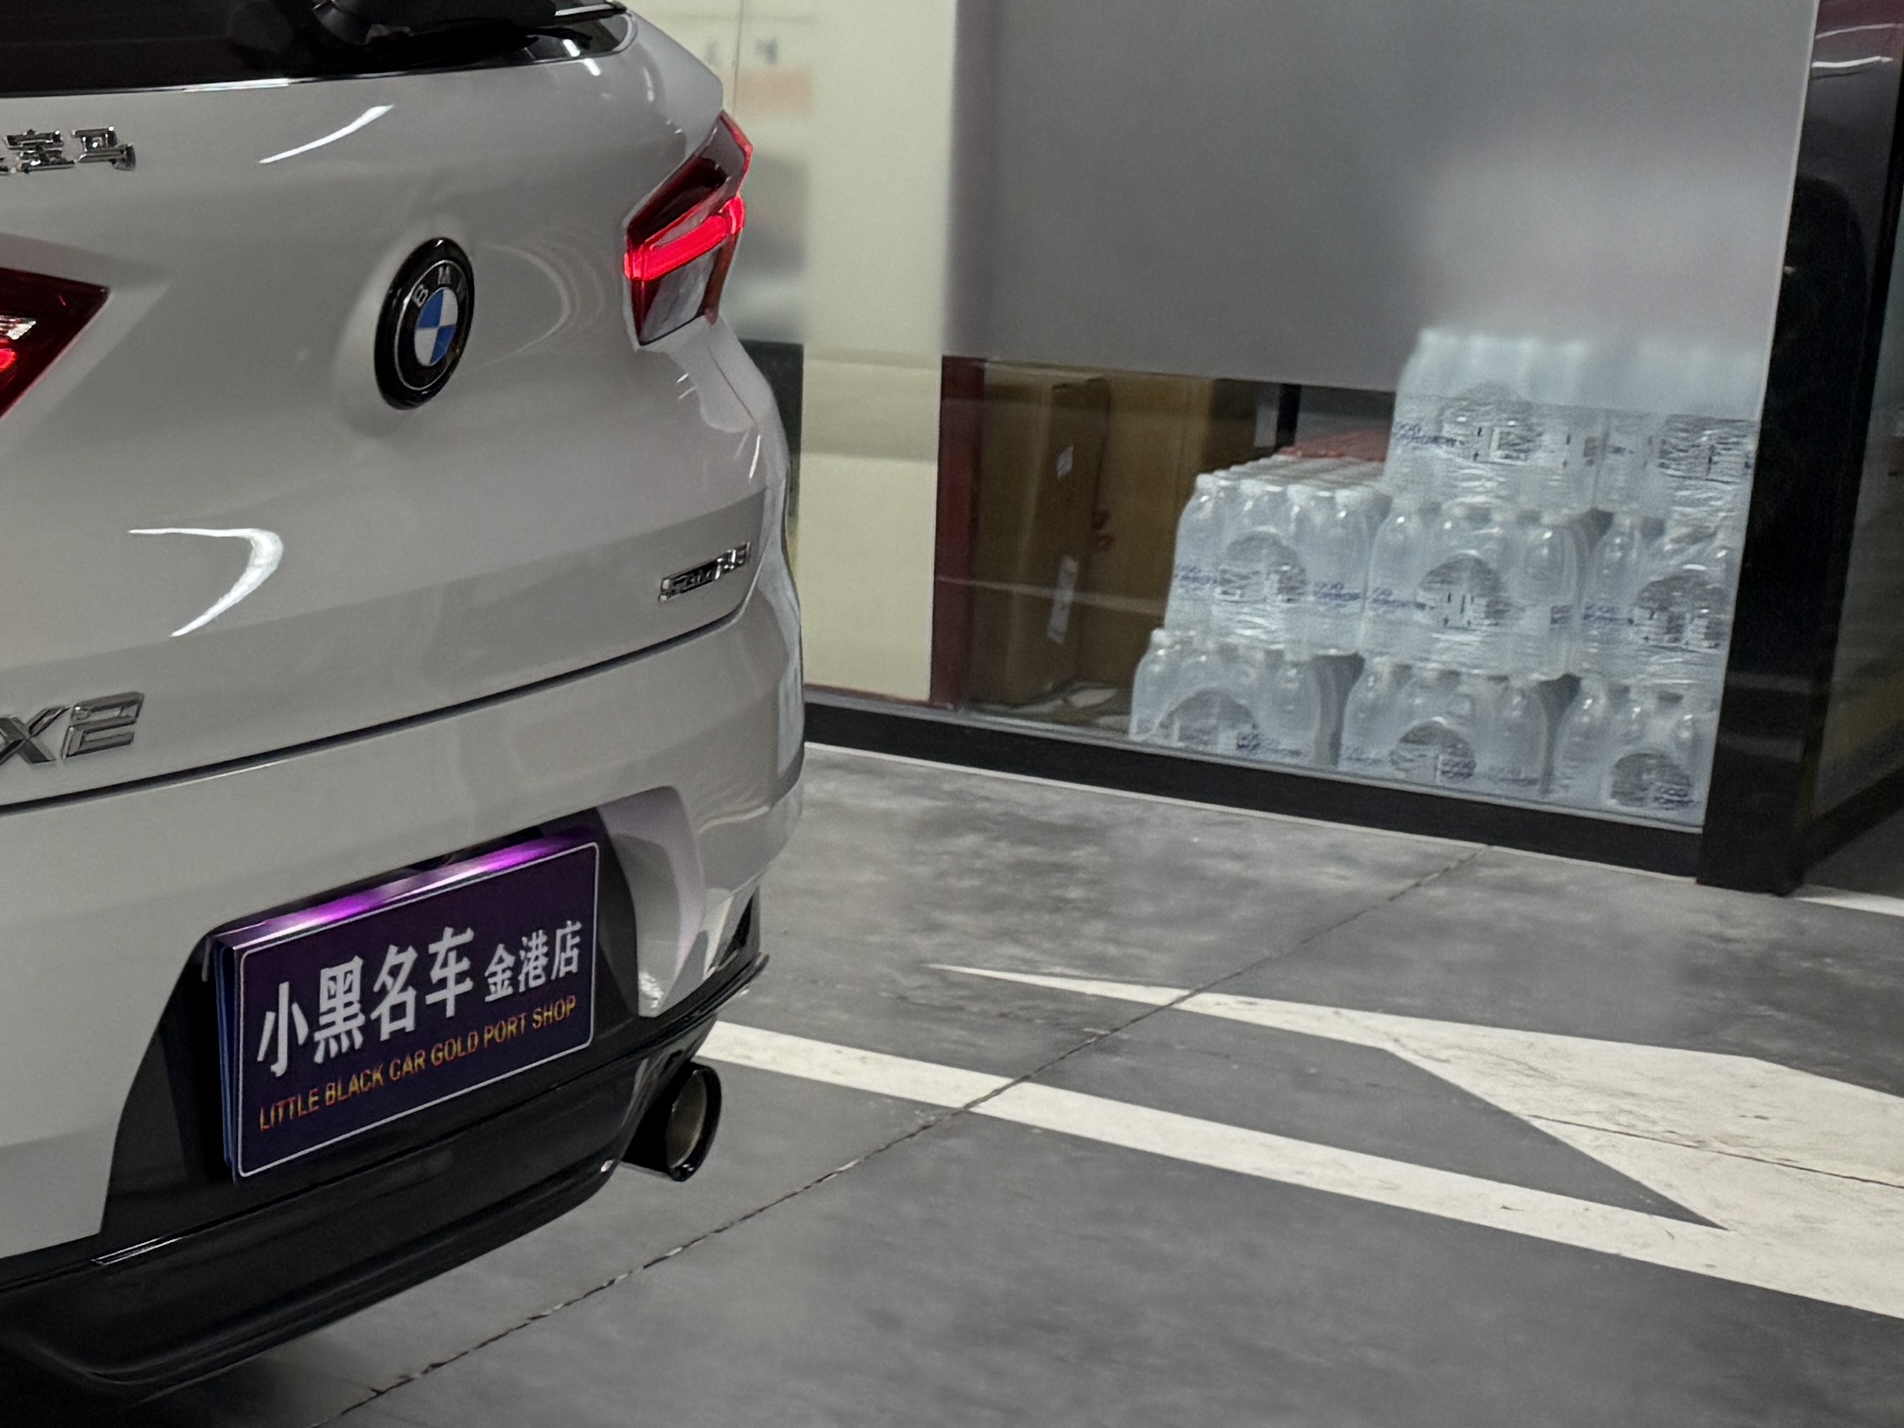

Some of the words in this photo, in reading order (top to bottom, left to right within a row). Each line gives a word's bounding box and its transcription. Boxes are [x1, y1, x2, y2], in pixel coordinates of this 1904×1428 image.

[256, 926, 476, 1077] 小黑名车
[484, 919, 583, 1003] 金港店
[258, 1087, 320, 1132] LITTLE
[324, 1067, 385, 1108] BLACK
[389, 1049, 427, 1082] CAR
[430, 1030, 480, 1067] GOLD
[483, 1012, 528, 1049] PORT
[531, 994, 577, 1031] SHOP
